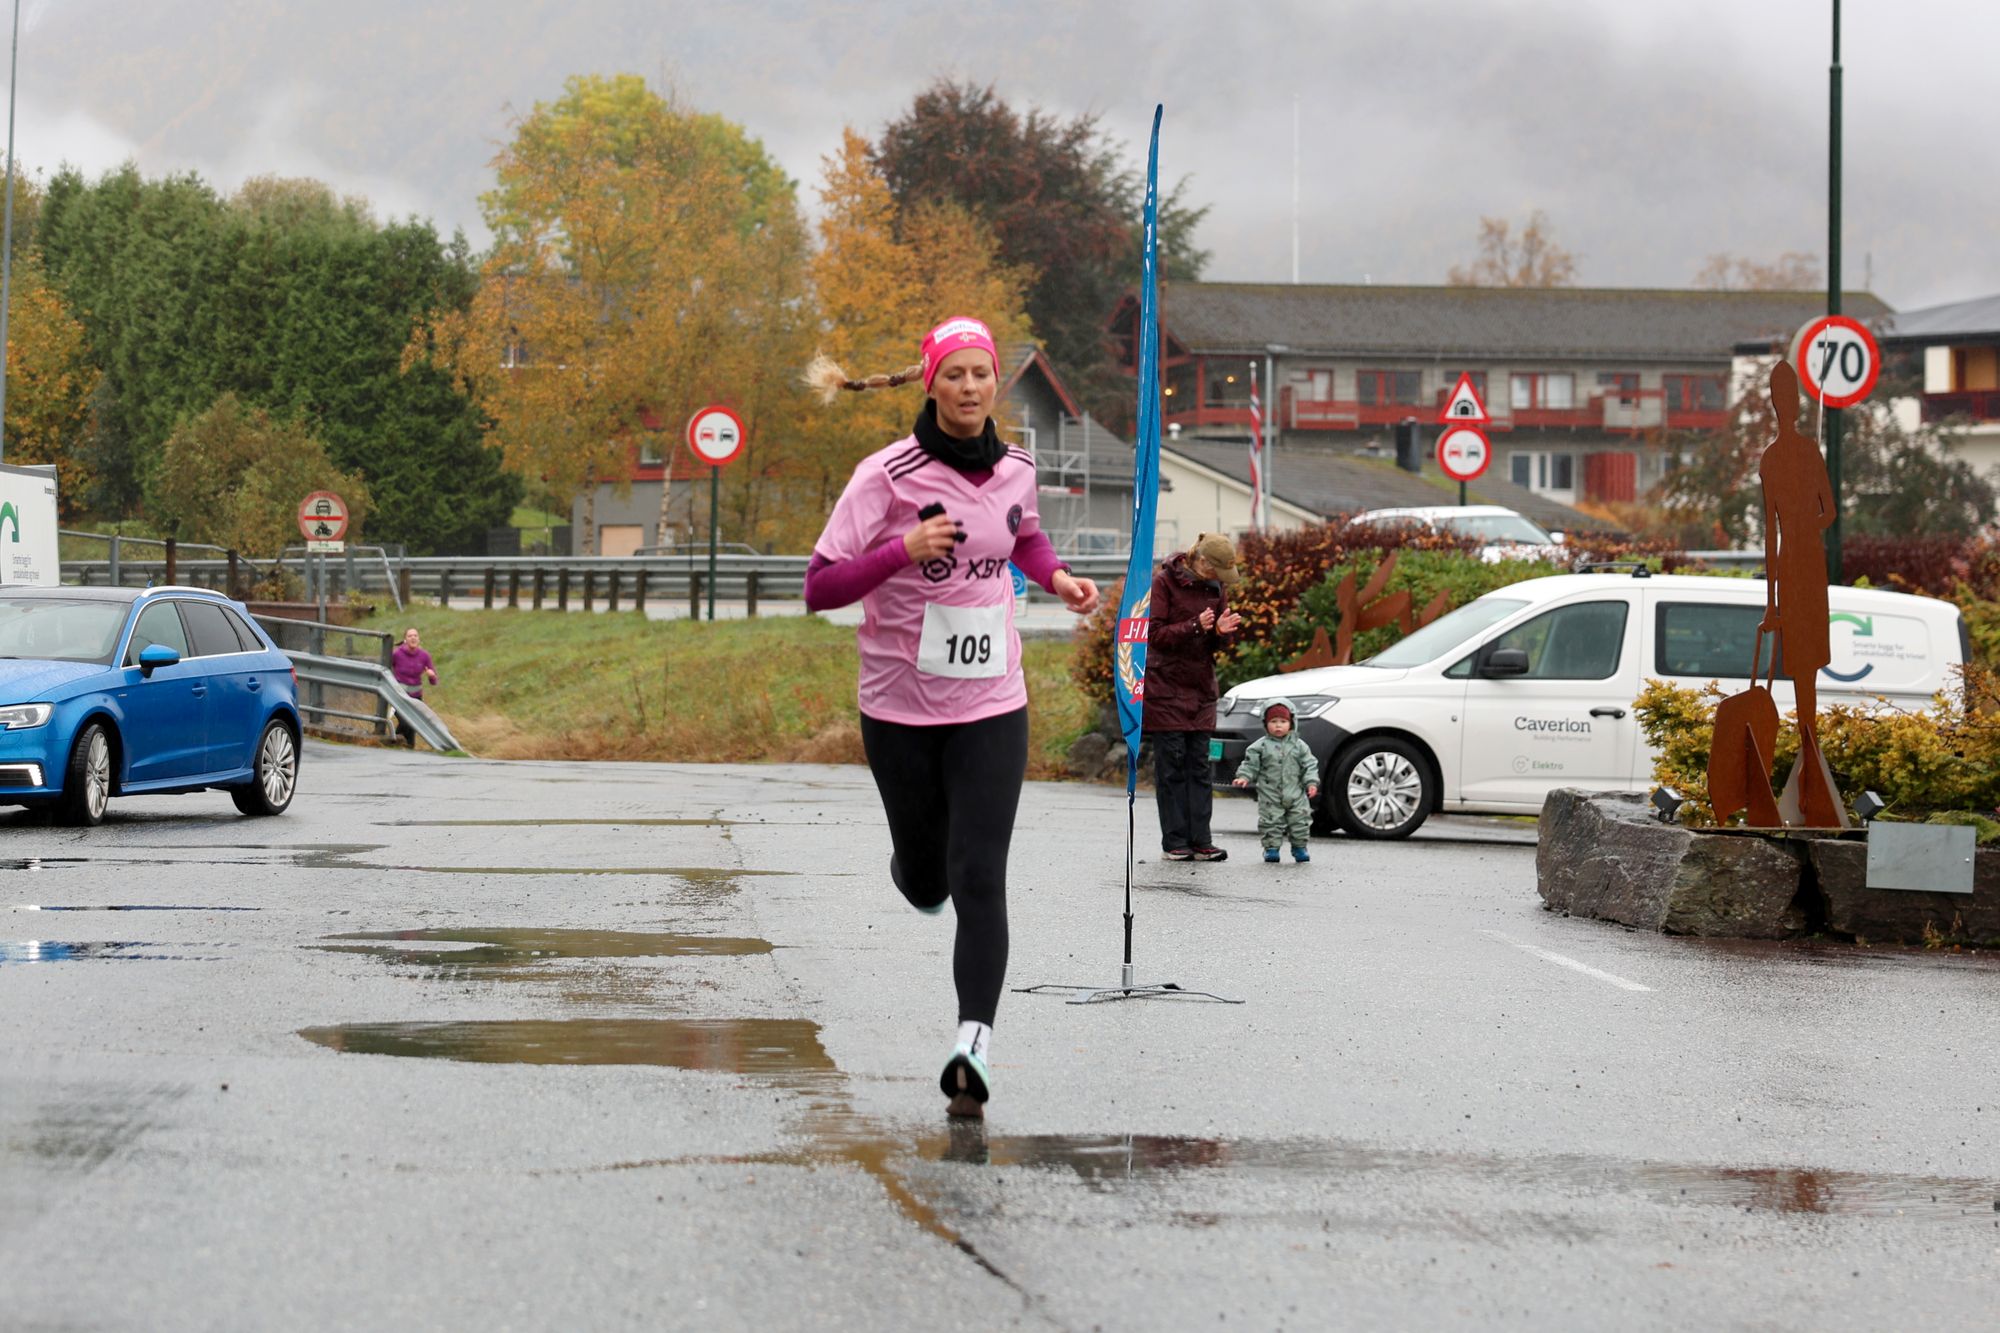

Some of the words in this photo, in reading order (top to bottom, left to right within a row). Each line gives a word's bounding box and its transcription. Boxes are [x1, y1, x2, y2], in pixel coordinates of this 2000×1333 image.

[1817, 341, 1864, 382] 70
[945, 634, 991, 664] 109
[1514, 717, 1592, 733] Caverion
[1532, 761, 1563, 770] Elektro
